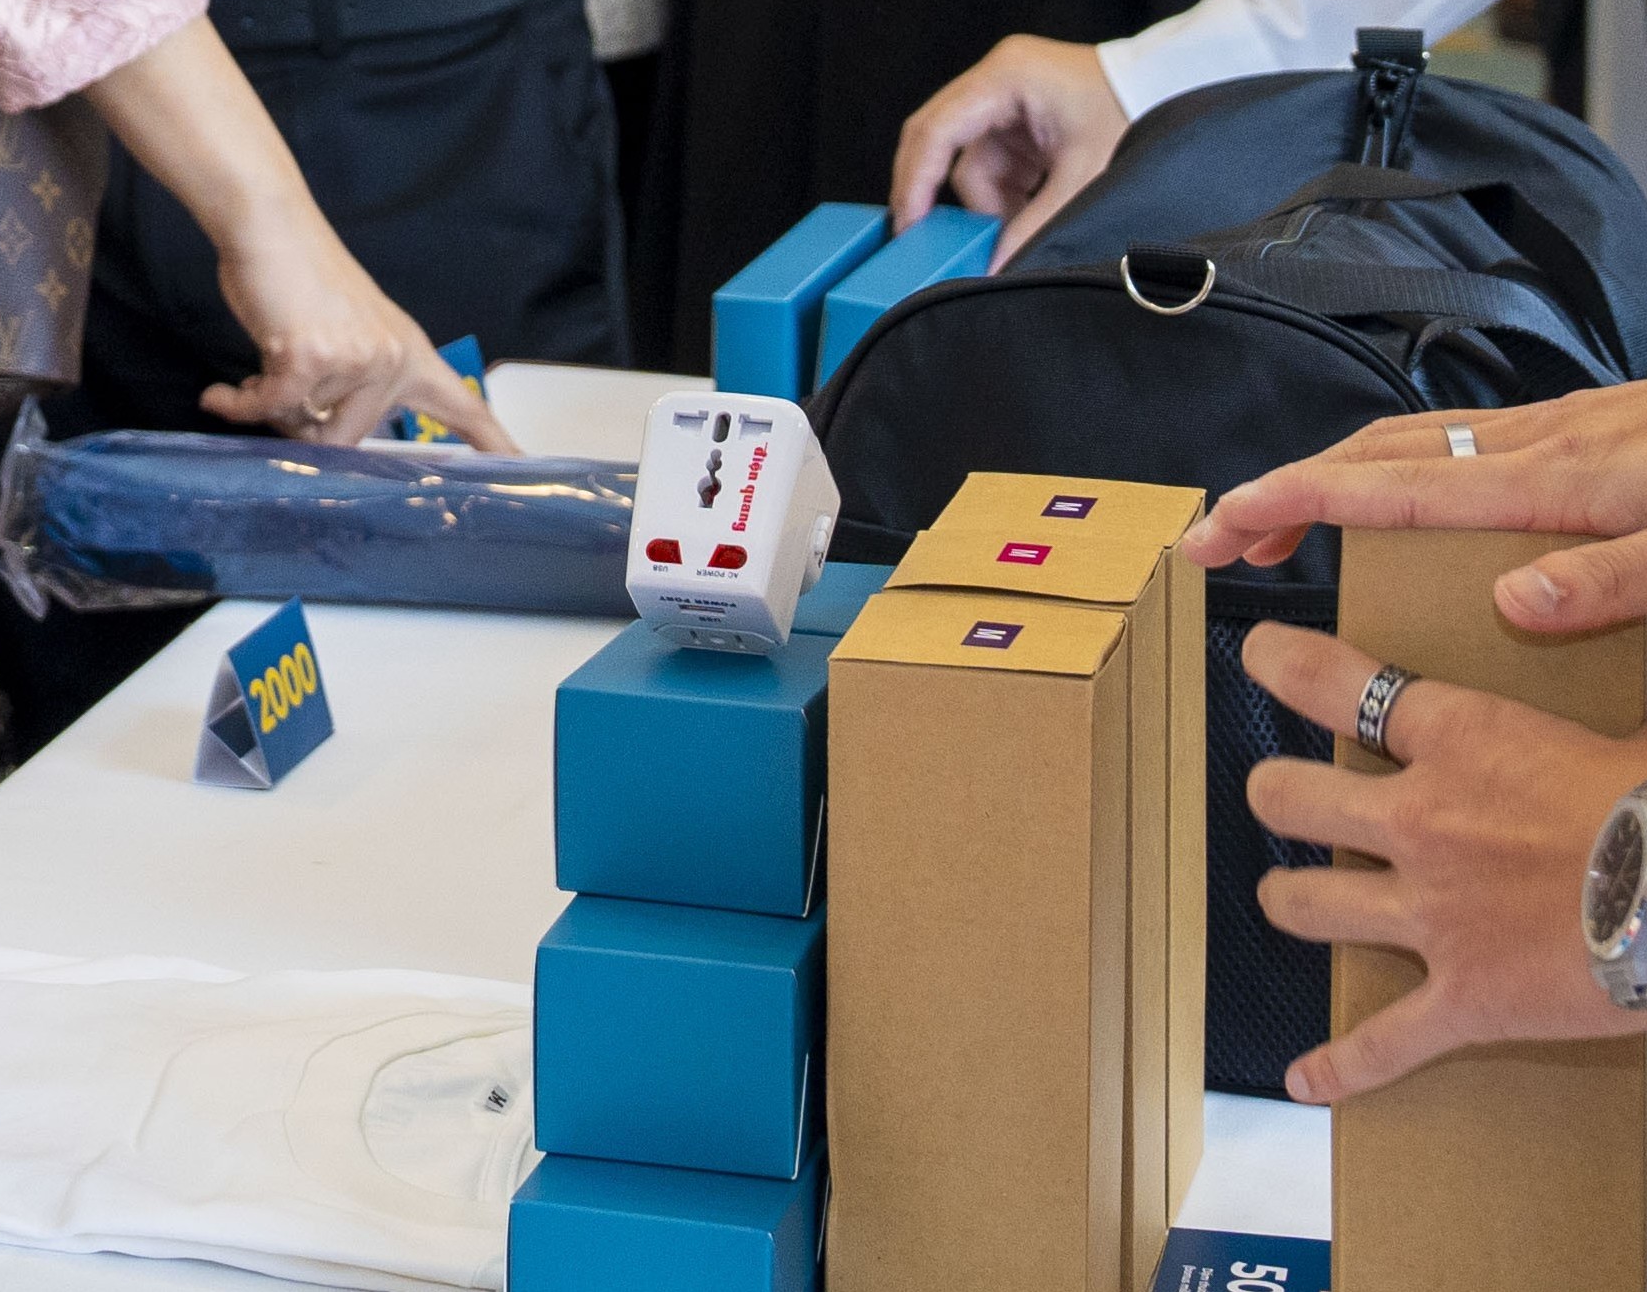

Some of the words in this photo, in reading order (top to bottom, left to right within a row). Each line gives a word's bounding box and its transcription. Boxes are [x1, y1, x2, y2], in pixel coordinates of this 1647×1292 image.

[732, 484, 755, 532] quang
[696, 569, 726, 579] POWER
[658, 595, 692, 605] PORT
[694, 599, 737, 608] POWER
[249, 641, 318, 734] 2000
